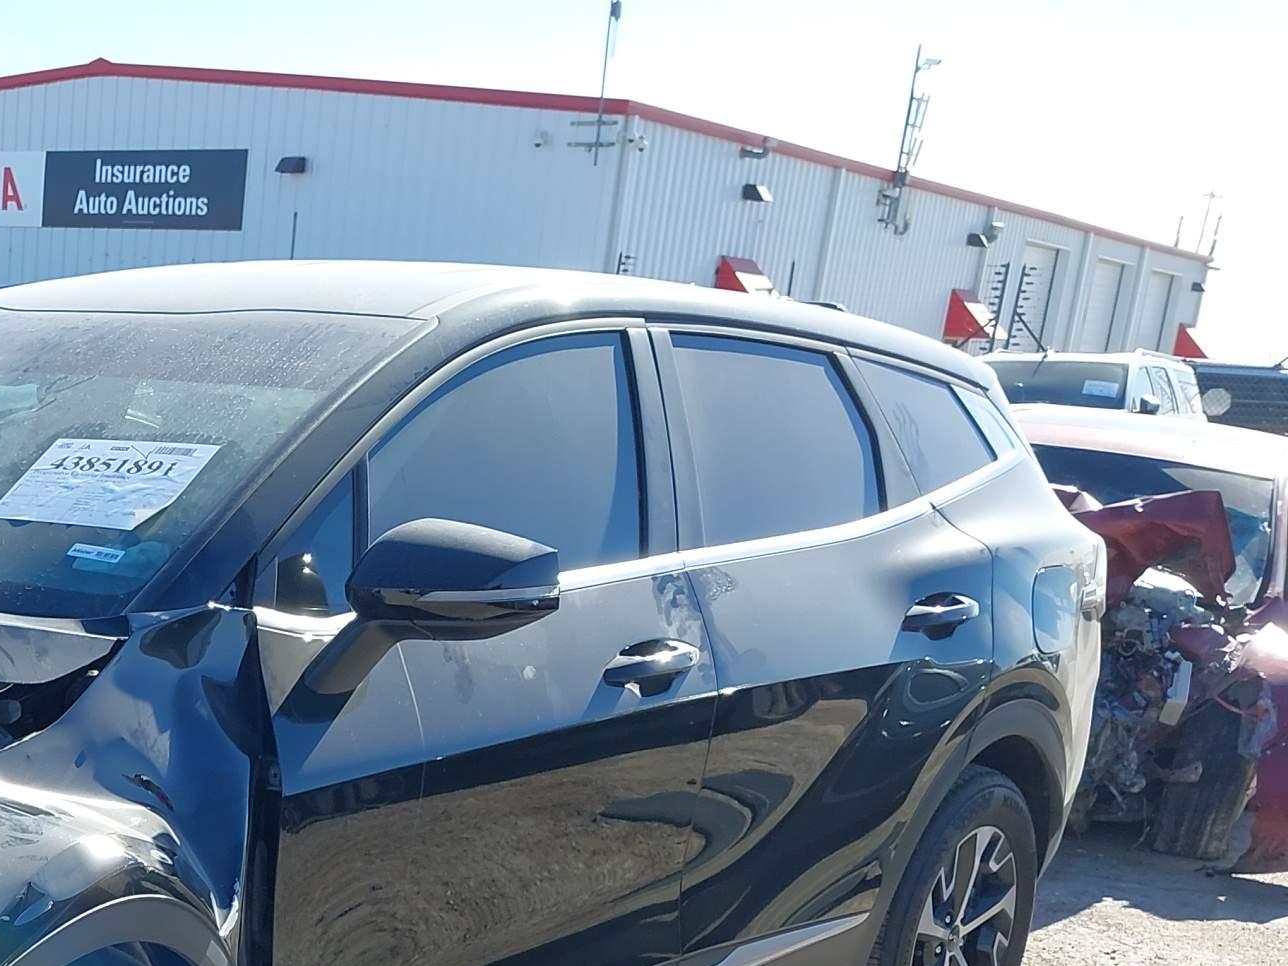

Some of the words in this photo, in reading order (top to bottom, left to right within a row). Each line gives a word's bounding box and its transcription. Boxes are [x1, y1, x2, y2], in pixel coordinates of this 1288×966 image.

[95, 158, 191, 184] Insurance
[73, 190, 117, 215] Auto
[122, 190, 209, 216] Auctions
[49, 455, 178, 478] 43851891
